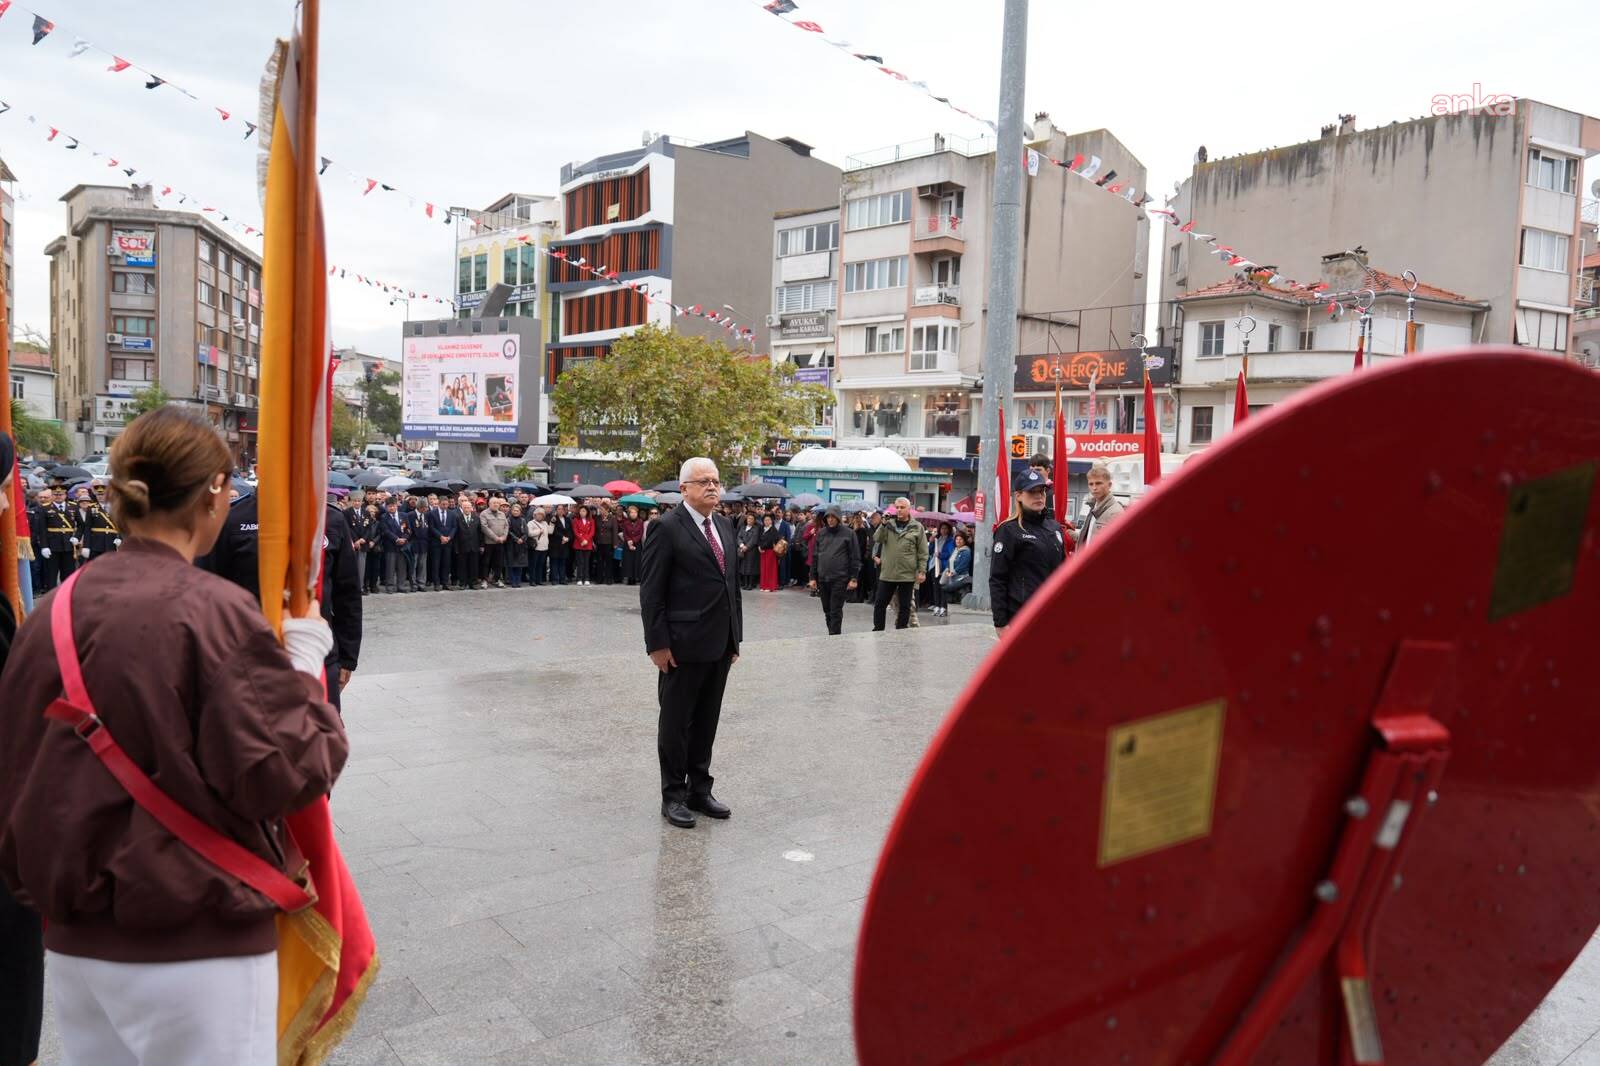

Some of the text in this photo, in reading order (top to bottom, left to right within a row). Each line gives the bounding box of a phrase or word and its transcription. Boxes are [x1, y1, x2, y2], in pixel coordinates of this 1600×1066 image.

[790, 317, 817, 326] AVUKAT
[1021, 419, 1039, 430] 542
[1080, 439, 1139, 453] vodafone
